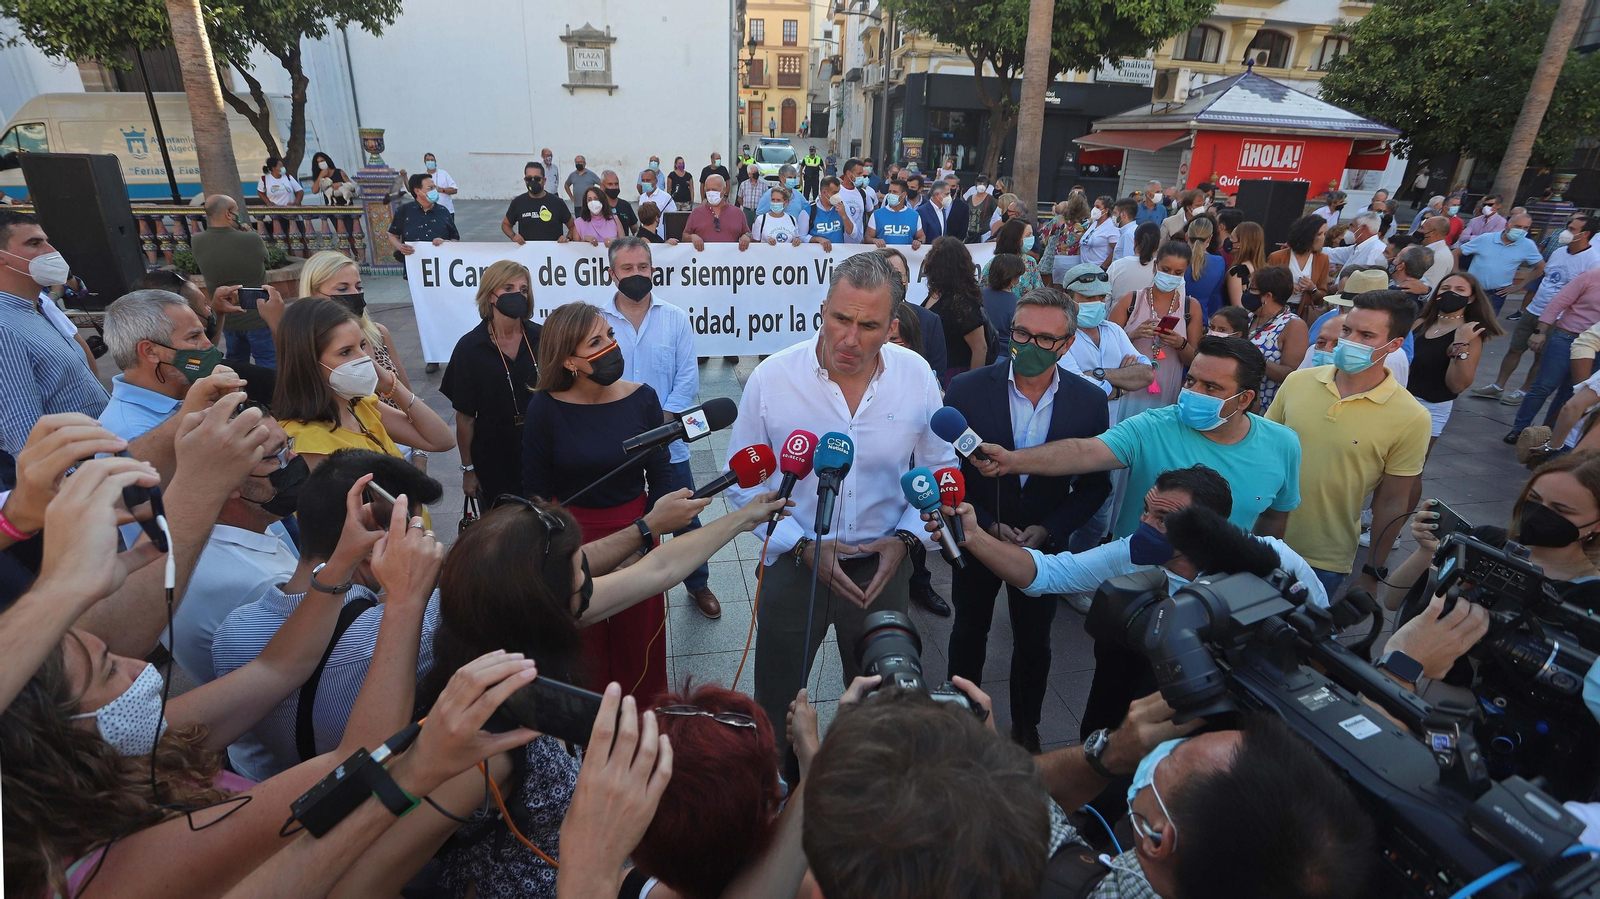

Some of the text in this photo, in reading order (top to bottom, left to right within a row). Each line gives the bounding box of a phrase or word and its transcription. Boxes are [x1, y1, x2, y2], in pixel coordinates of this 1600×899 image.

[1120, 59, 1151, 69] Análisis
[1118, 69, 1150, 79] Clínicos
[1240, 142, 1302, 169] ¡HOLA!
[816, 220, 841, 232] SUP
[884, 224, 910, 235] SUP
[421, 257, 441, 287] El
[538, 256, 567, 287] de
[681, 257, 766, 294] siempre
[772, 264, 808, 286] con
[748, 313, 783, 341] por
[789, 305, 806, 332] la
[745, 446, 761, 464] rne
[827, 444, 849, 455] Noticias
[917, 488, 934, 501] COPE
